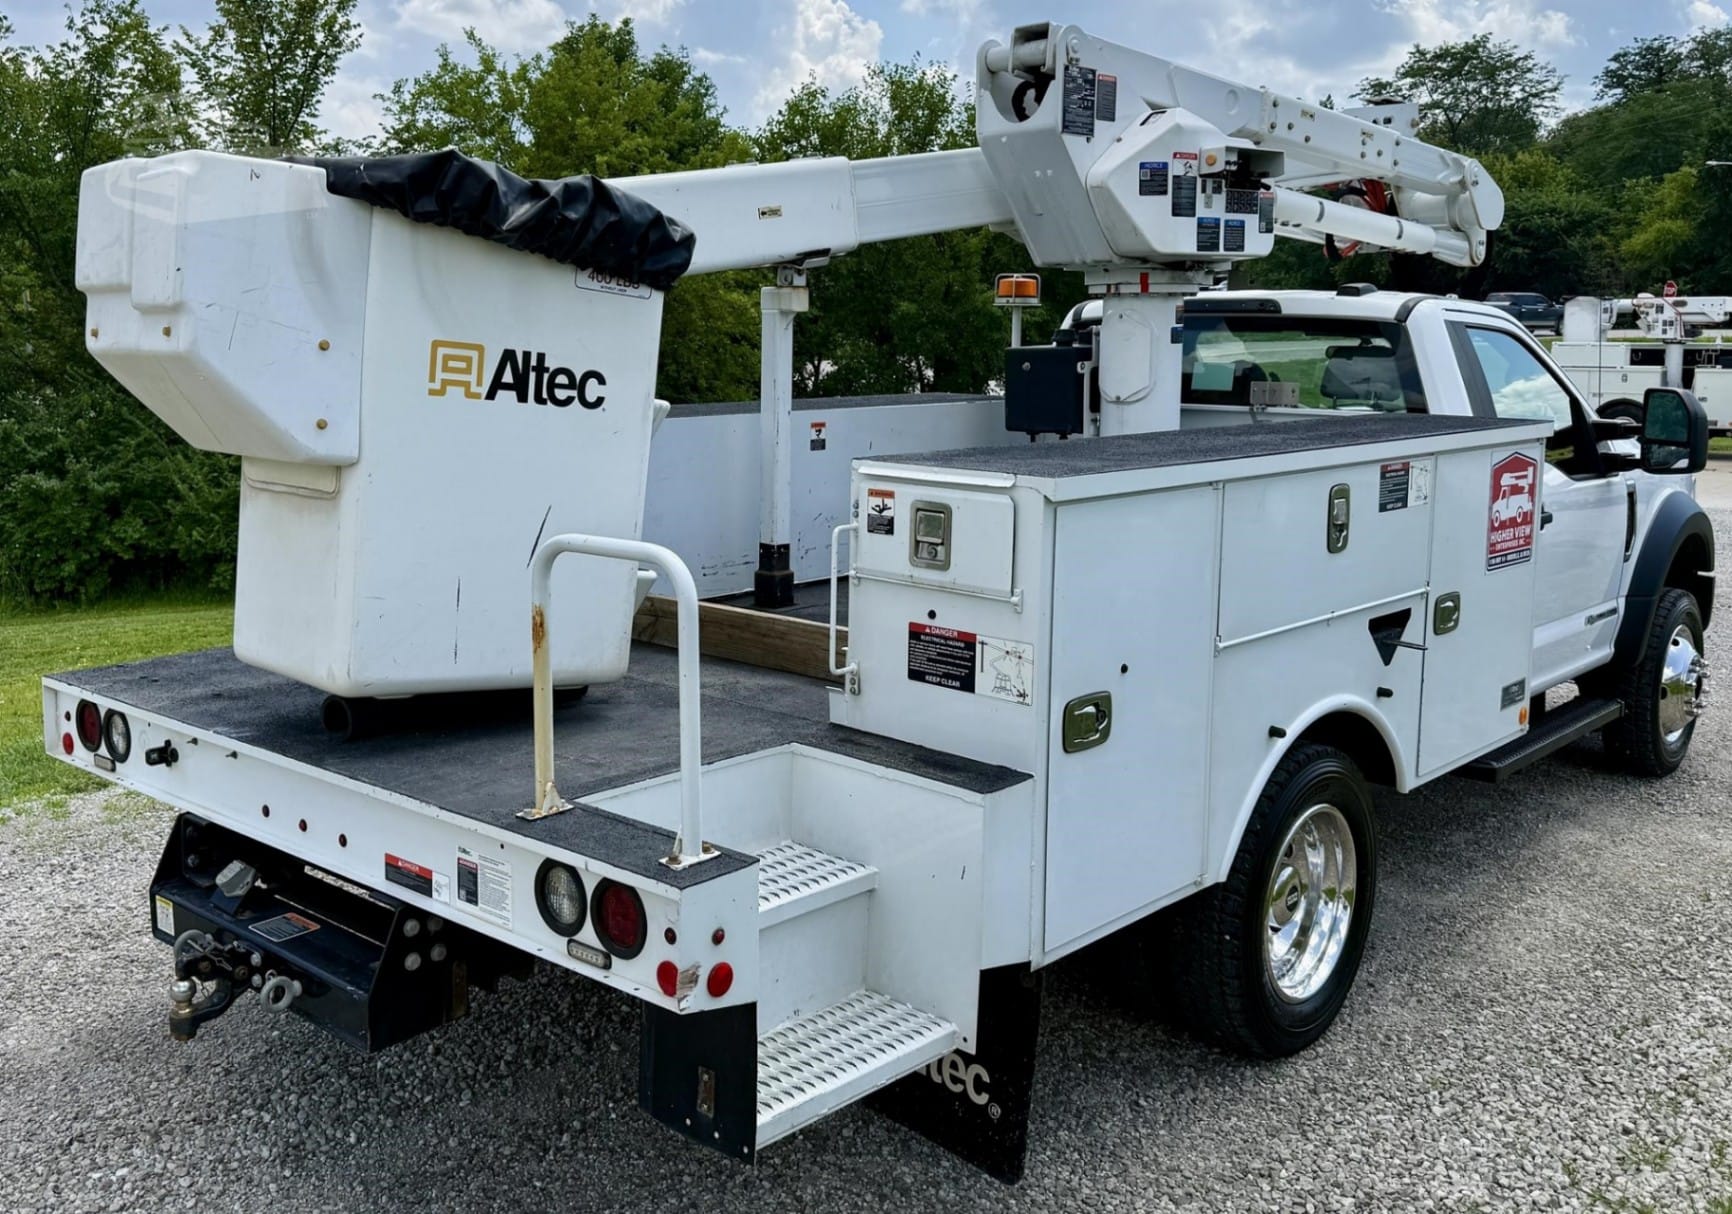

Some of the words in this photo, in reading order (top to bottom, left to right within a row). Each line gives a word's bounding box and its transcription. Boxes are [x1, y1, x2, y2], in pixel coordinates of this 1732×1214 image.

[587, 266, 612, 285] 400
[484, 348, 607, 410] Altec
[1490, 528, 1514, 544] HIGHER
[1514, 524, 1532, 539] VIEW
[931, 626, 958, 638] DANGER
[946, 639, 965, 648] HAZARD
[924, 674, 940, 684] KEEP
[941, 677, 961, 688] CLEAR
[913, 1052, 990, 1105] tec
